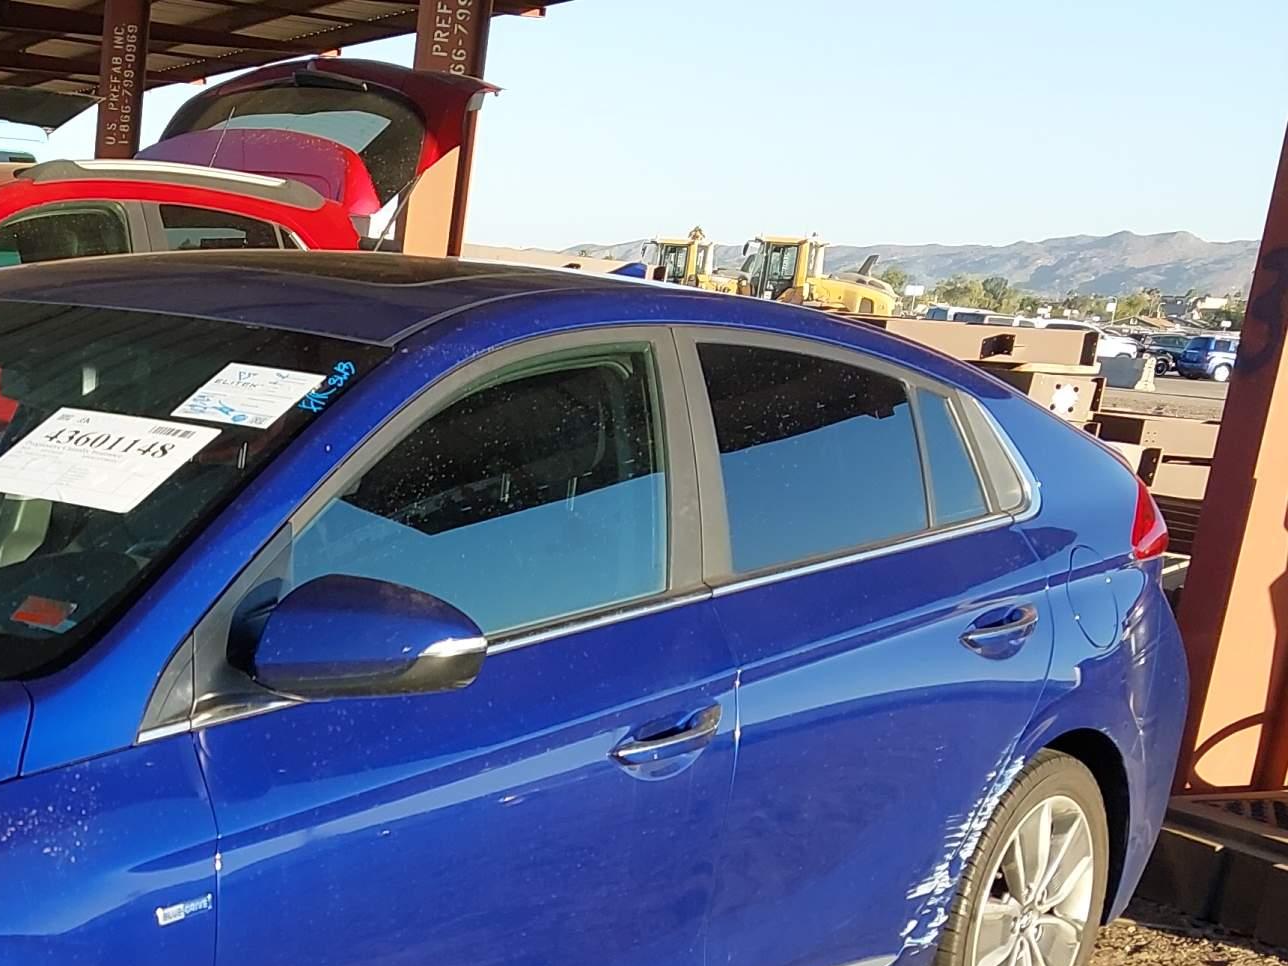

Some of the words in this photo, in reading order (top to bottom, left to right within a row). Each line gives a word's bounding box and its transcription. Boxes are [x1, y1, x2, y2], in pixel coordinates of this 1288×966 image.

[113, 23, 126, 49] INC.
[108, 56, 123, 111] PREFAB
[118, 24, 138, 144] 1-866-799-0969
[44, 427, 176, 459] 43601148
